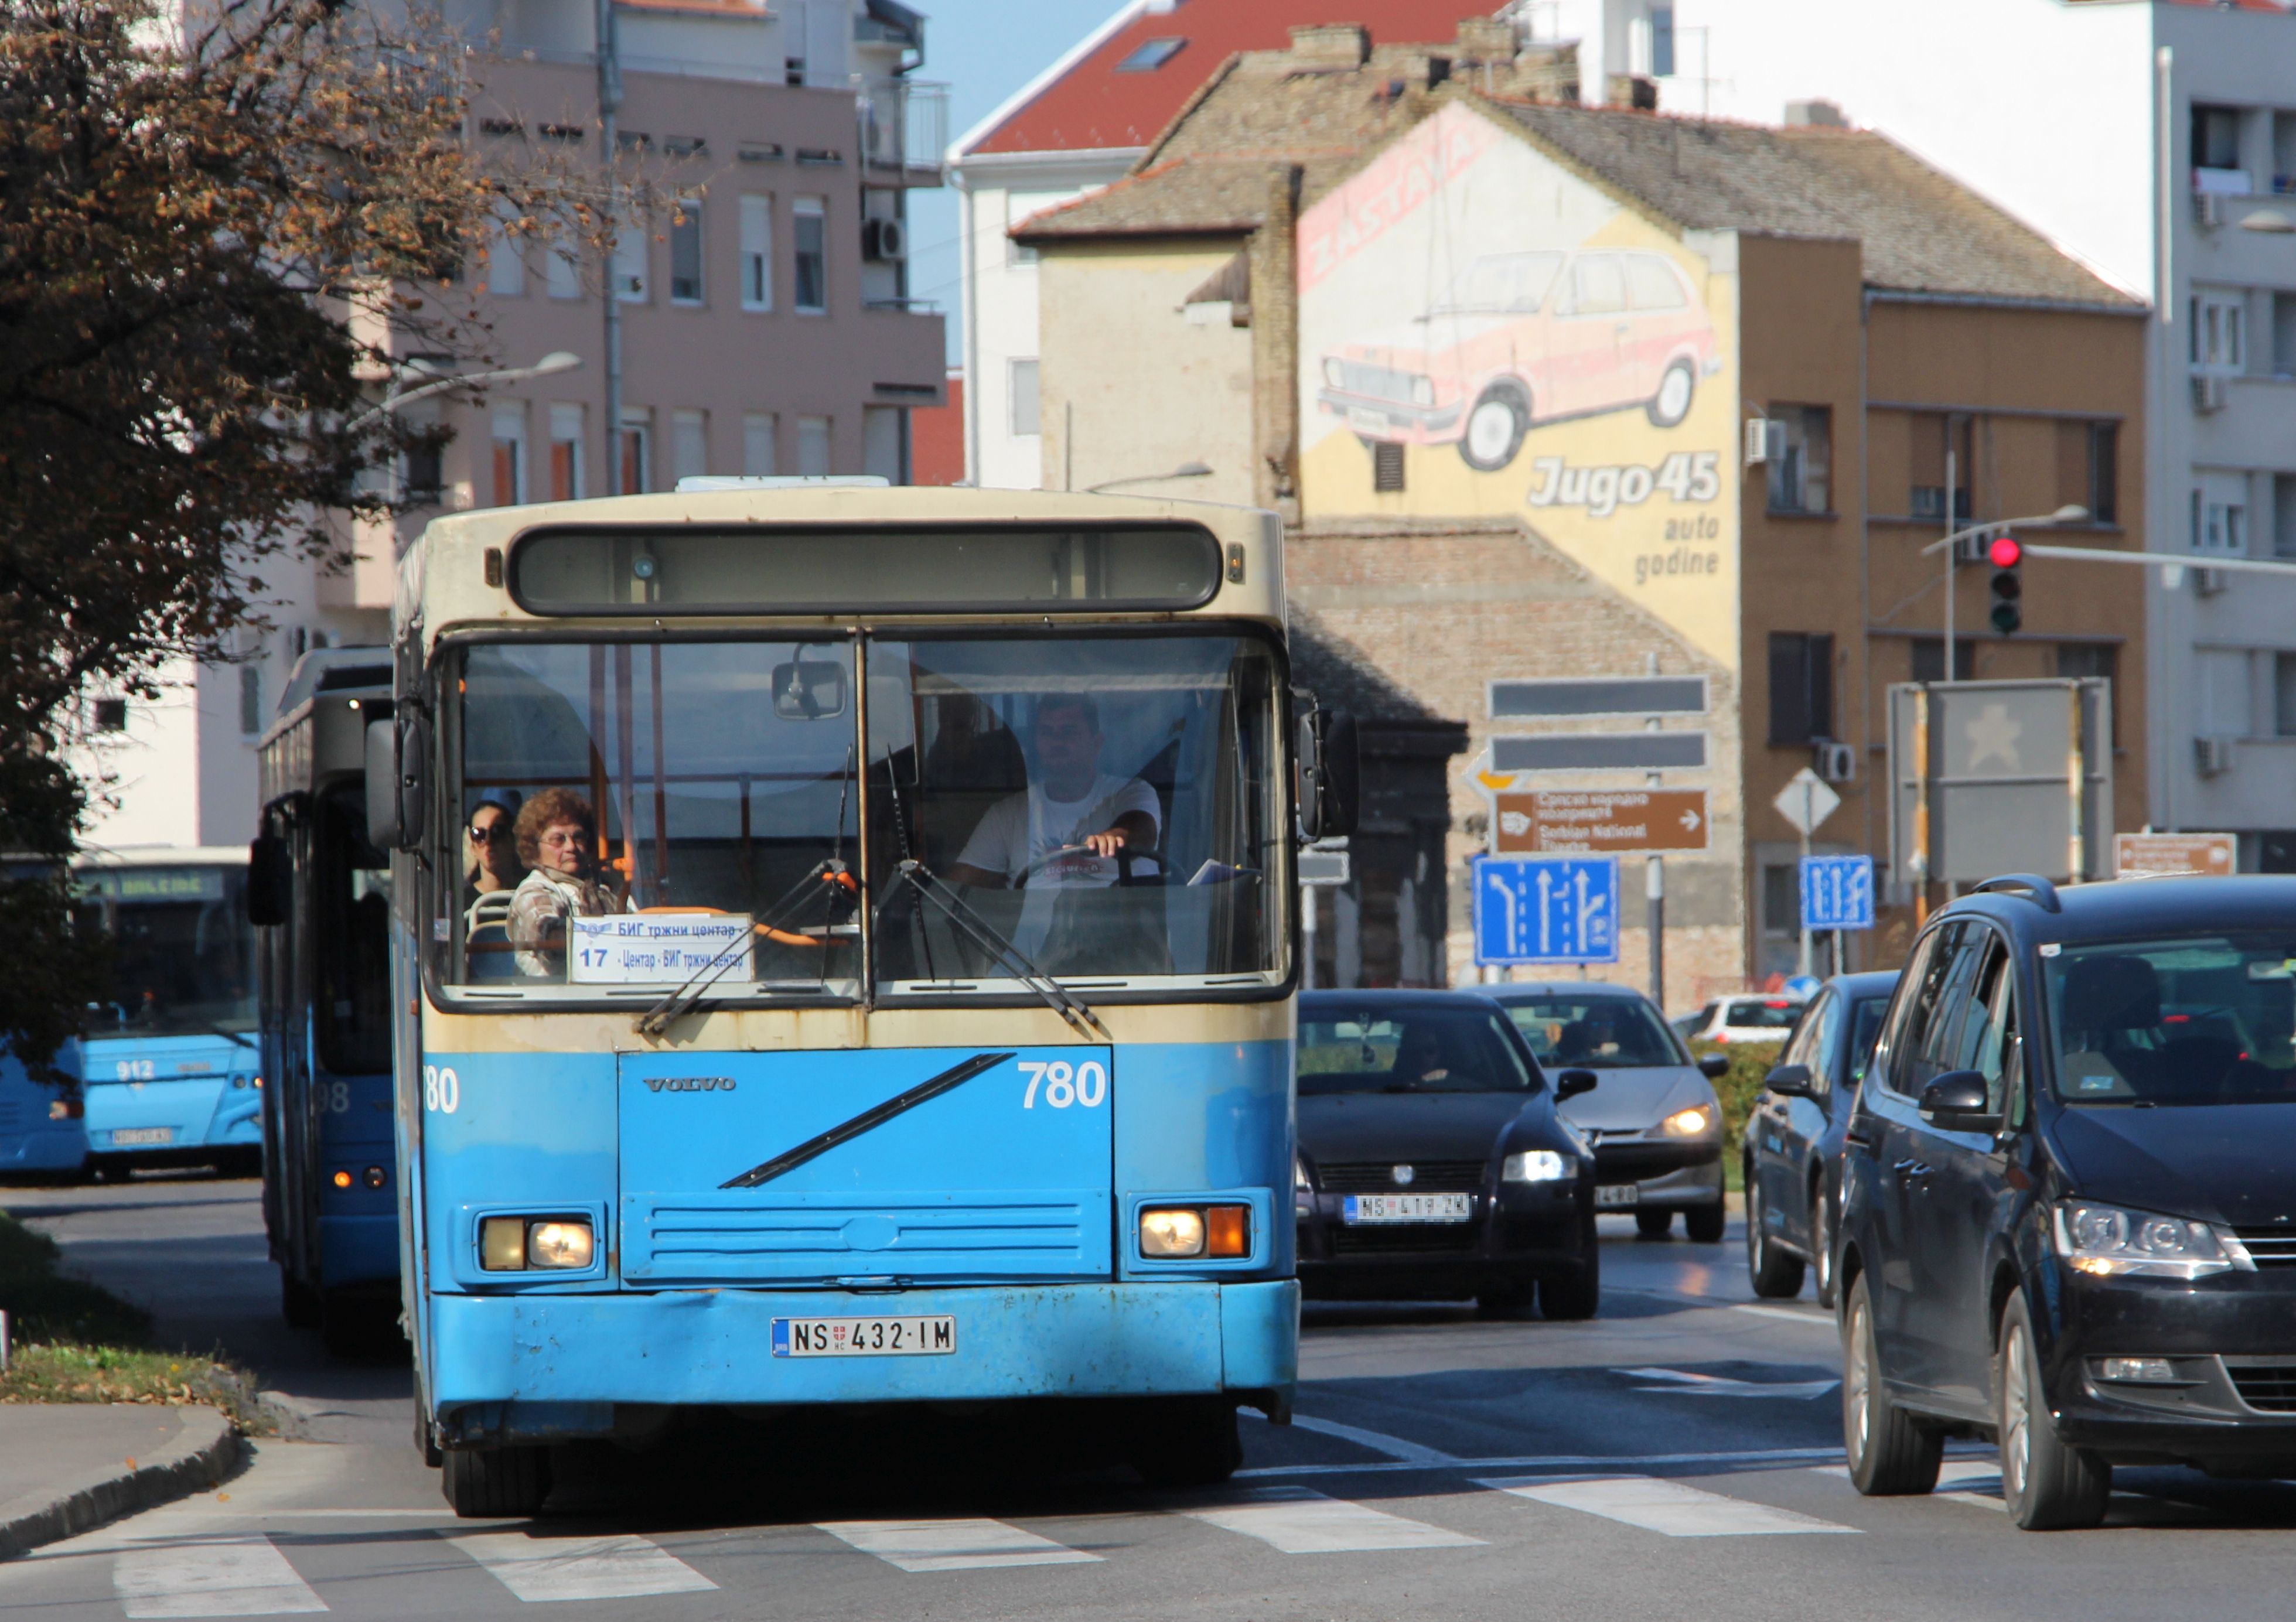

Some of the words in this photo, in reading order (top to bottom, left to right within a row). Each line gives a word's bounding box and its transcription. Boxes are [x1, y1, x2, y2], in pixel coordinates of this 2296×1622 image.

[1308, 130, 1476, 275] ZASTAVA
[1529, 455, 1654, 518] Jugo
[1656, 450, 1721, 503] 45
[1664, 511, 1720, 541] auto
[1635, 547, 1720, 585] godine
[1592, 823, 1646, 839] National
[618, 922, 643, 936] БИГ
[648, 927, 688, 940] тржни
[692, 926, 735, 938] центар
[579, 948, 608, 967] 17
[623, 950, 656, 970] Центар
[663, 950, 681, 967] БИГ
[116, 1059, 155, 1081] 912
[422, 1064, 459, 1114] 80
[643, 1077, 736, 1092] VOLVO
[1018, 1060, 1107, 1109] 780
[794, 1324, 827, 1350] NS
